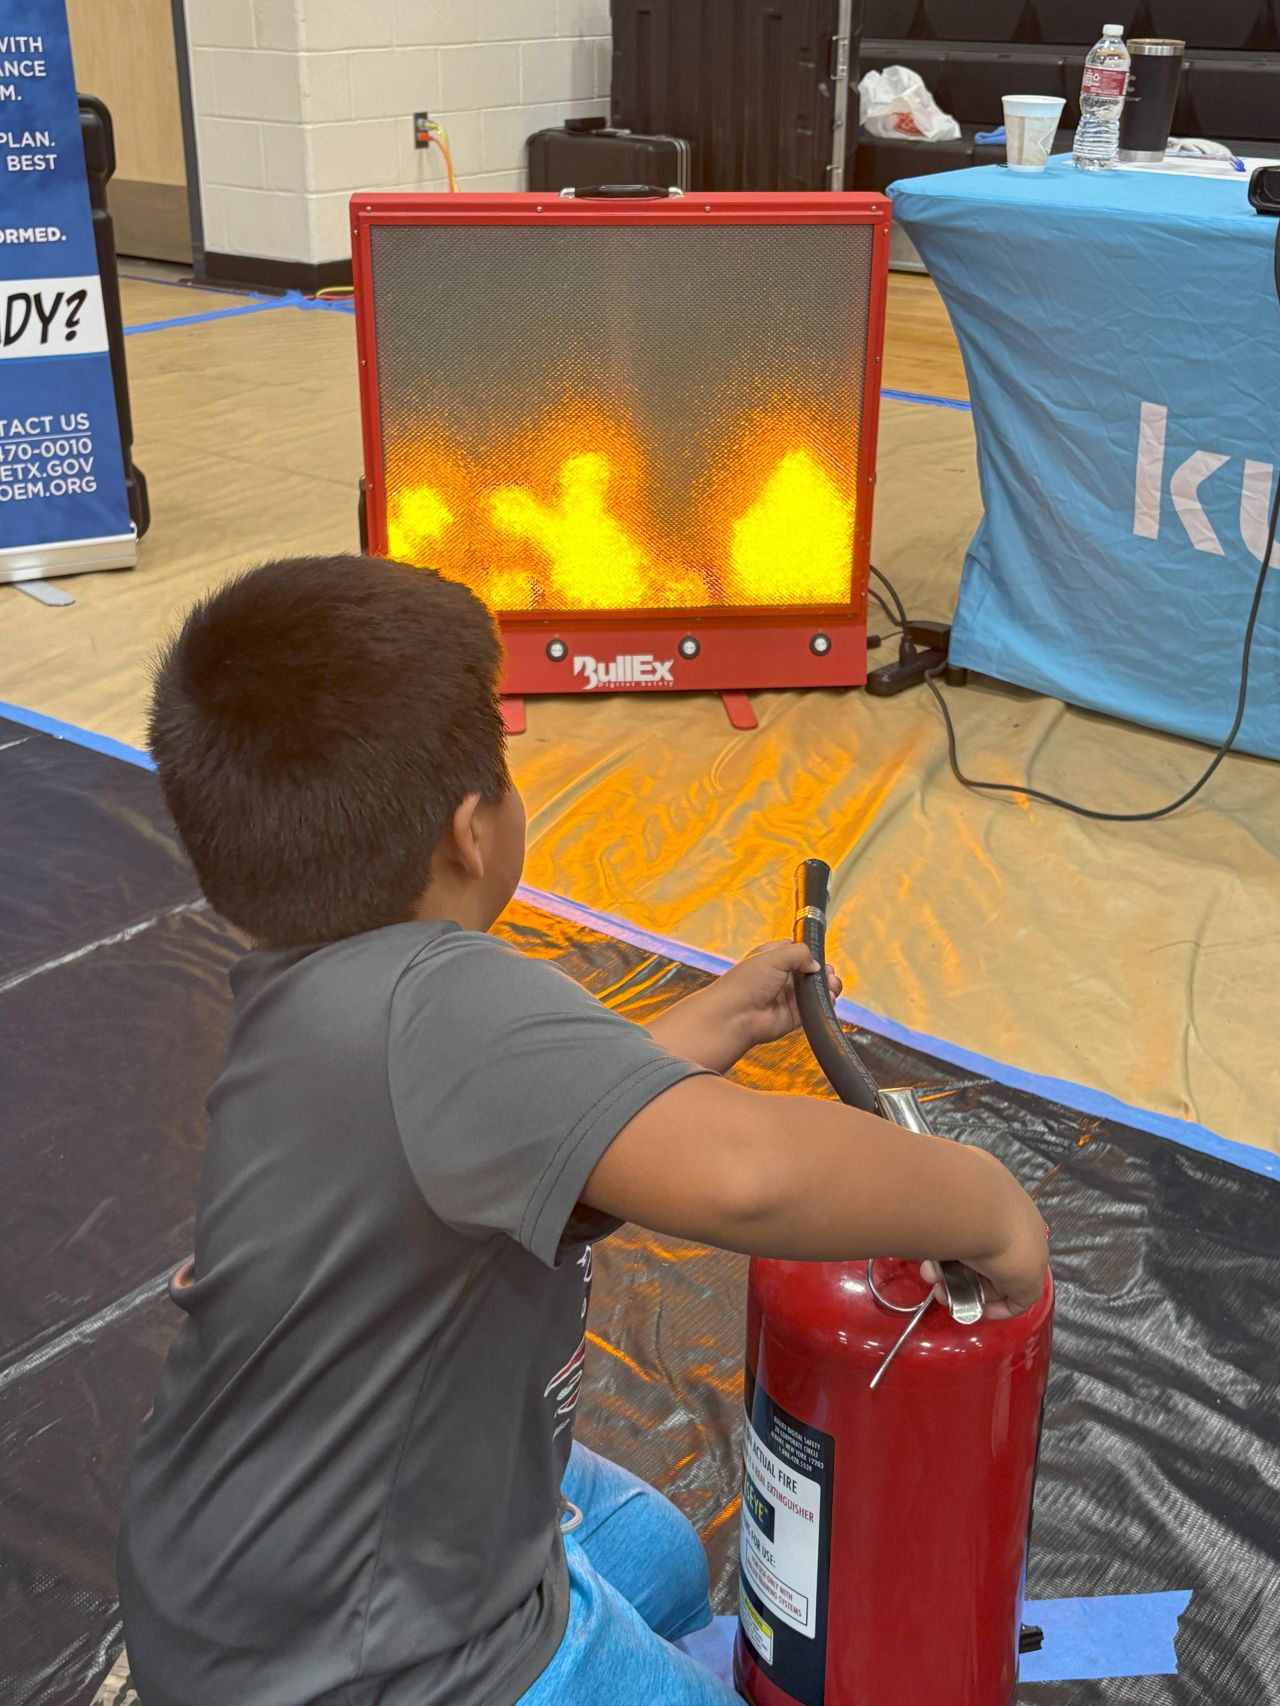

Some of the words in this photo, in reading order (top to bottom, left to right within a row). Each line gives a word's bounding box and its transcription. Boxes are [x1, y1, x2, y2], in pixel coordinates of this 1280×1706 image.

[6, 154, 57, 171] BEST
[0, 289, 87, 347] DY?
[60, 412, 90, 431] US
[573, 654, 674, 690] BullEx
[752, 1441, 776, 1479] ACTUAL
[778, 1468, 798, 1495] FIRE
[766, 1481, 815, 1524] EXTINGUISHER
[778, 1594, 803, 1618] SYSTEMS
